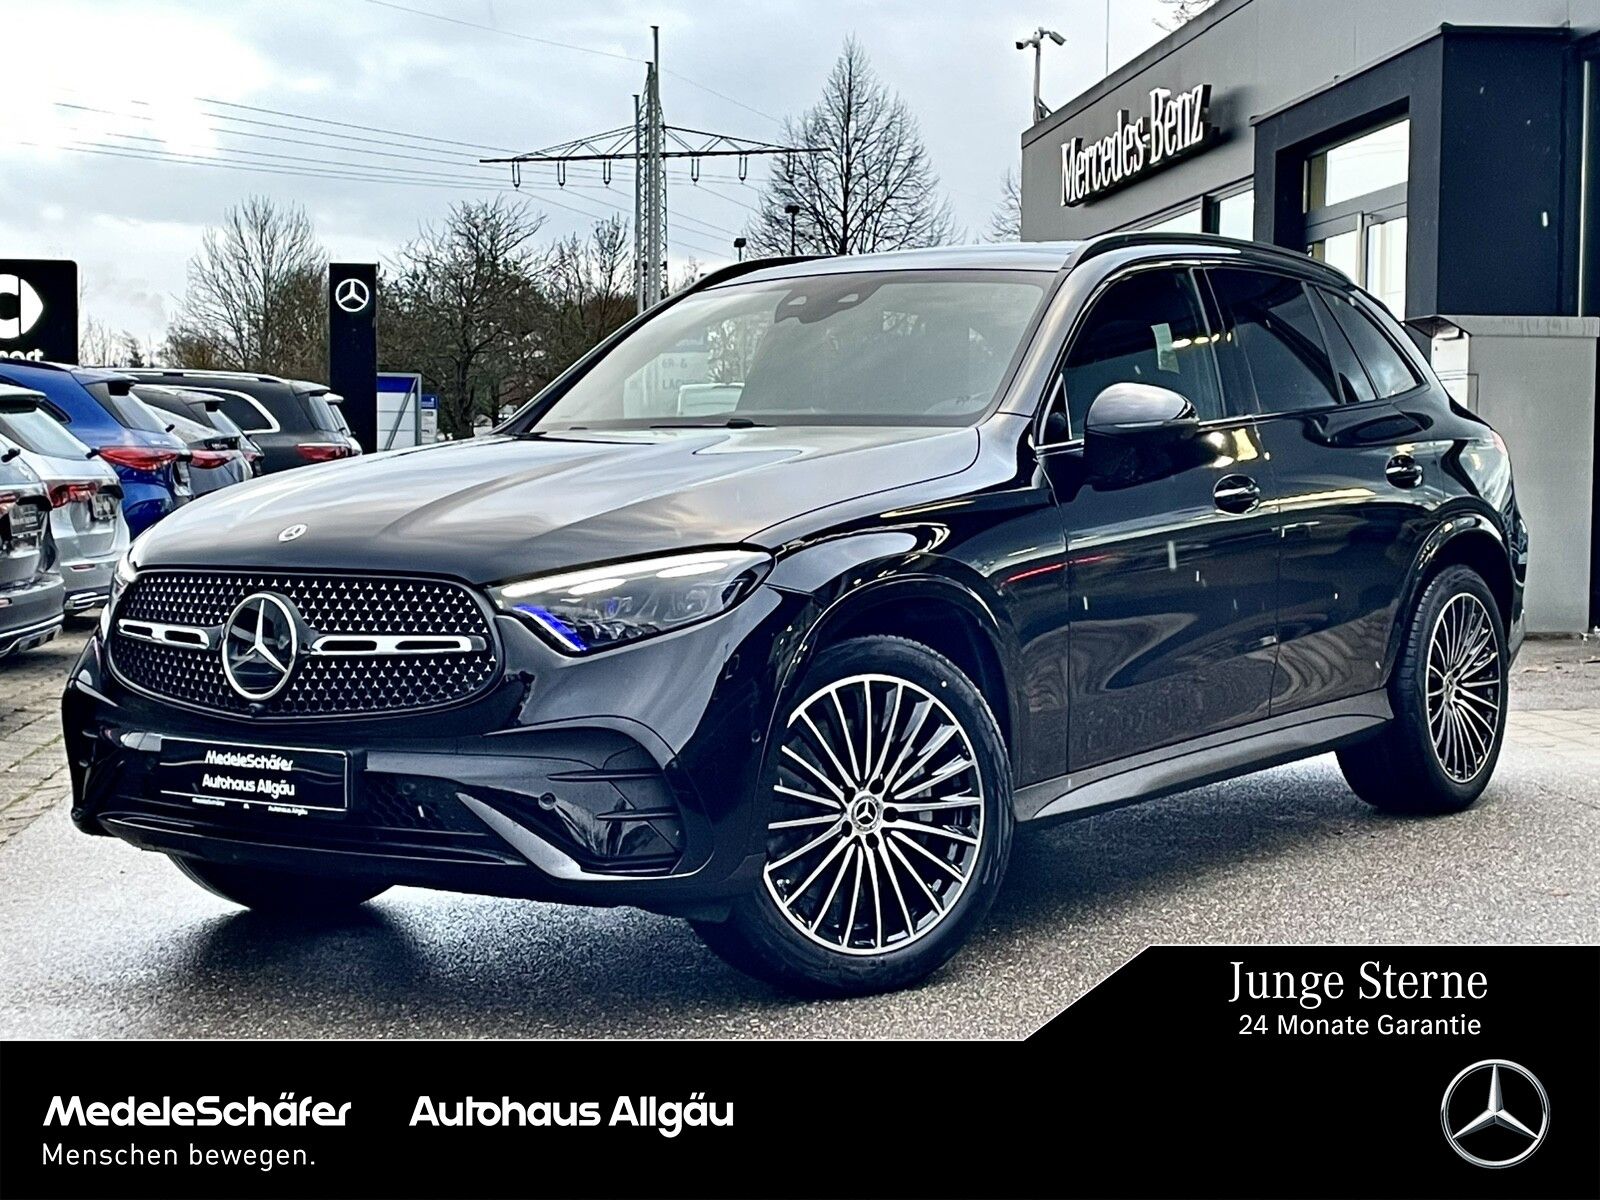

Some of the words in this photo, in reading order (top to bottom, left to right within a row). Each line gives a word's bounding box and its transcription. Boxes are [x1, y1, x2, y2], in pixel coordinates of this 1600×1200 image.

[1060, 83, 1205, 206] Mercedes-Benz
[204, 750, 294, 771] MedeleSchäfer
[202, 774, 256, 792] Autohaus
[257, 779, 295, 799] Allgäu
